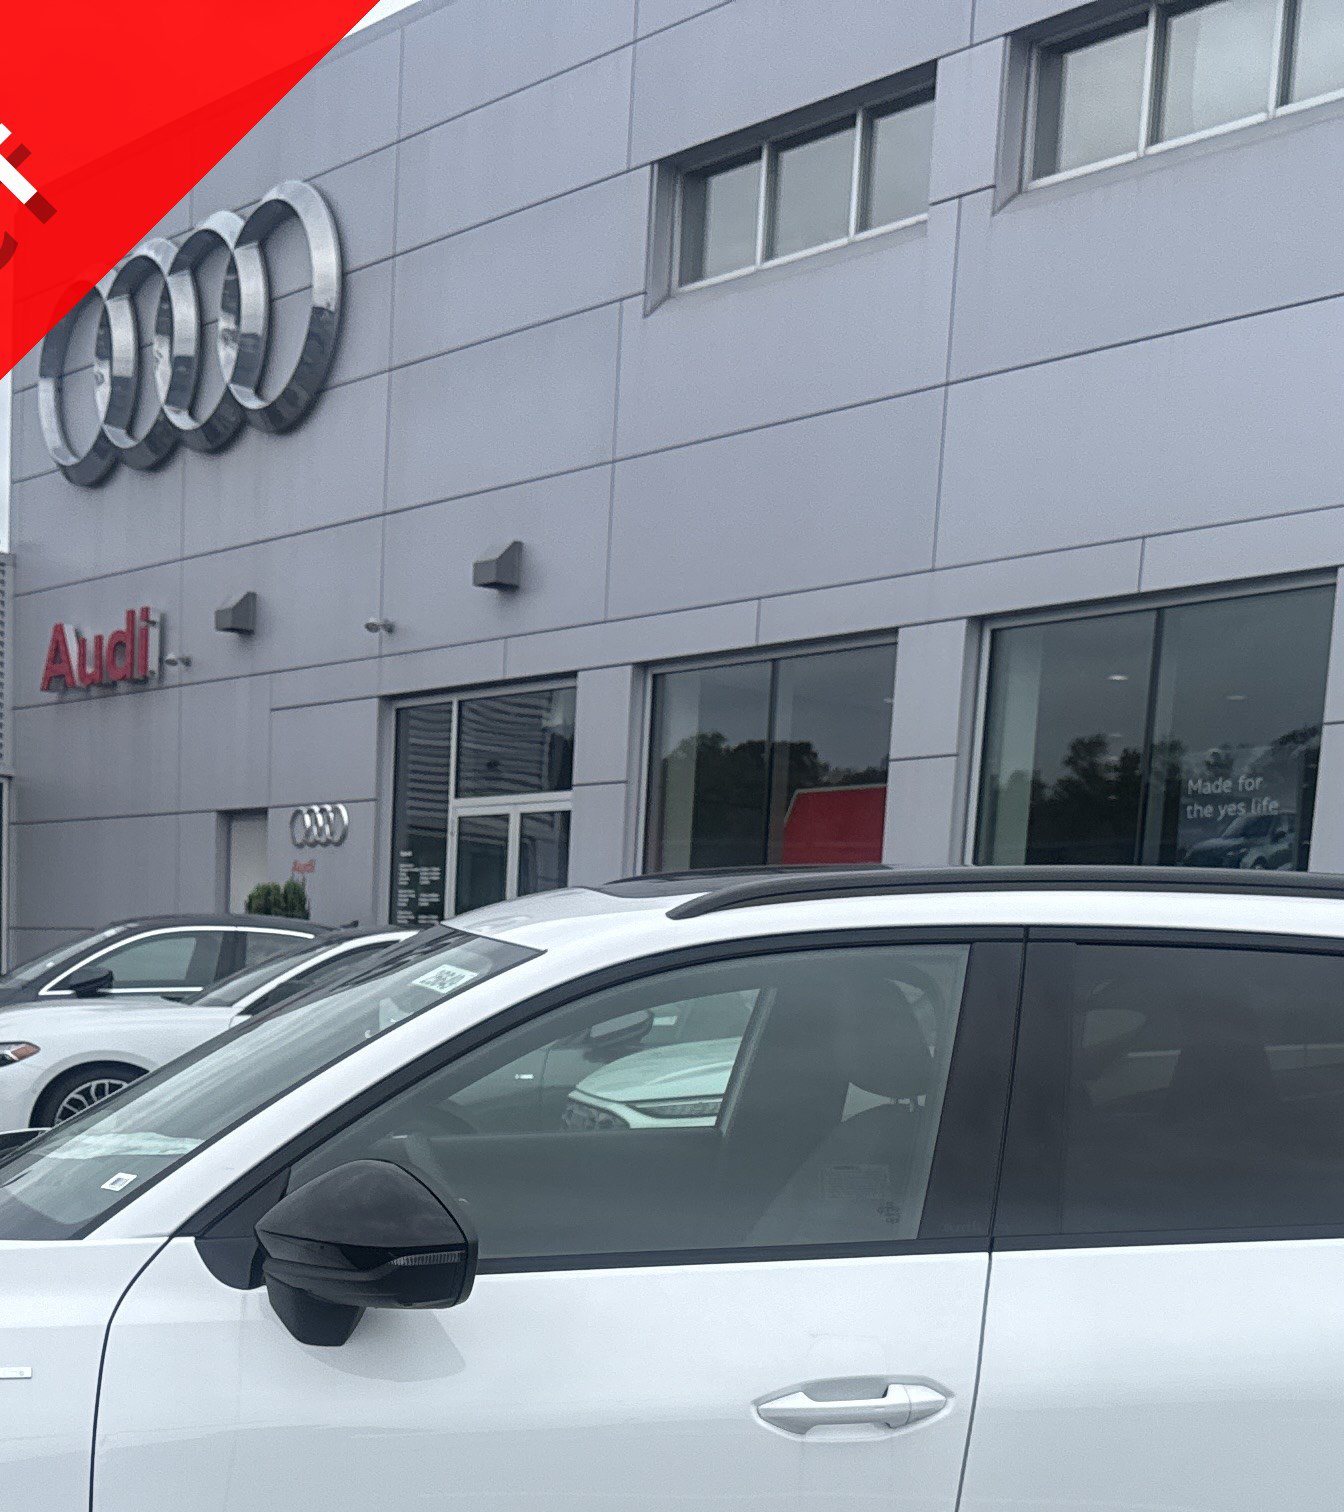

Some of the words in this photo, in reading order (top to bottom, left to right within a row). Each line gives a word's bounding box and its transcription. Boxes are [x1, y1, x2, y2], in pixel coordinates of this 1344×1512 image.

[40, 605, 155, 692] Audi
[1187, 777, 1233, 795] Made
[1238, 775, 1264, 792] for
[1186, 801, 1215, 819] the
[1218, 802, 1247, 821] yes
[1250, 797, 1280, 816] life
